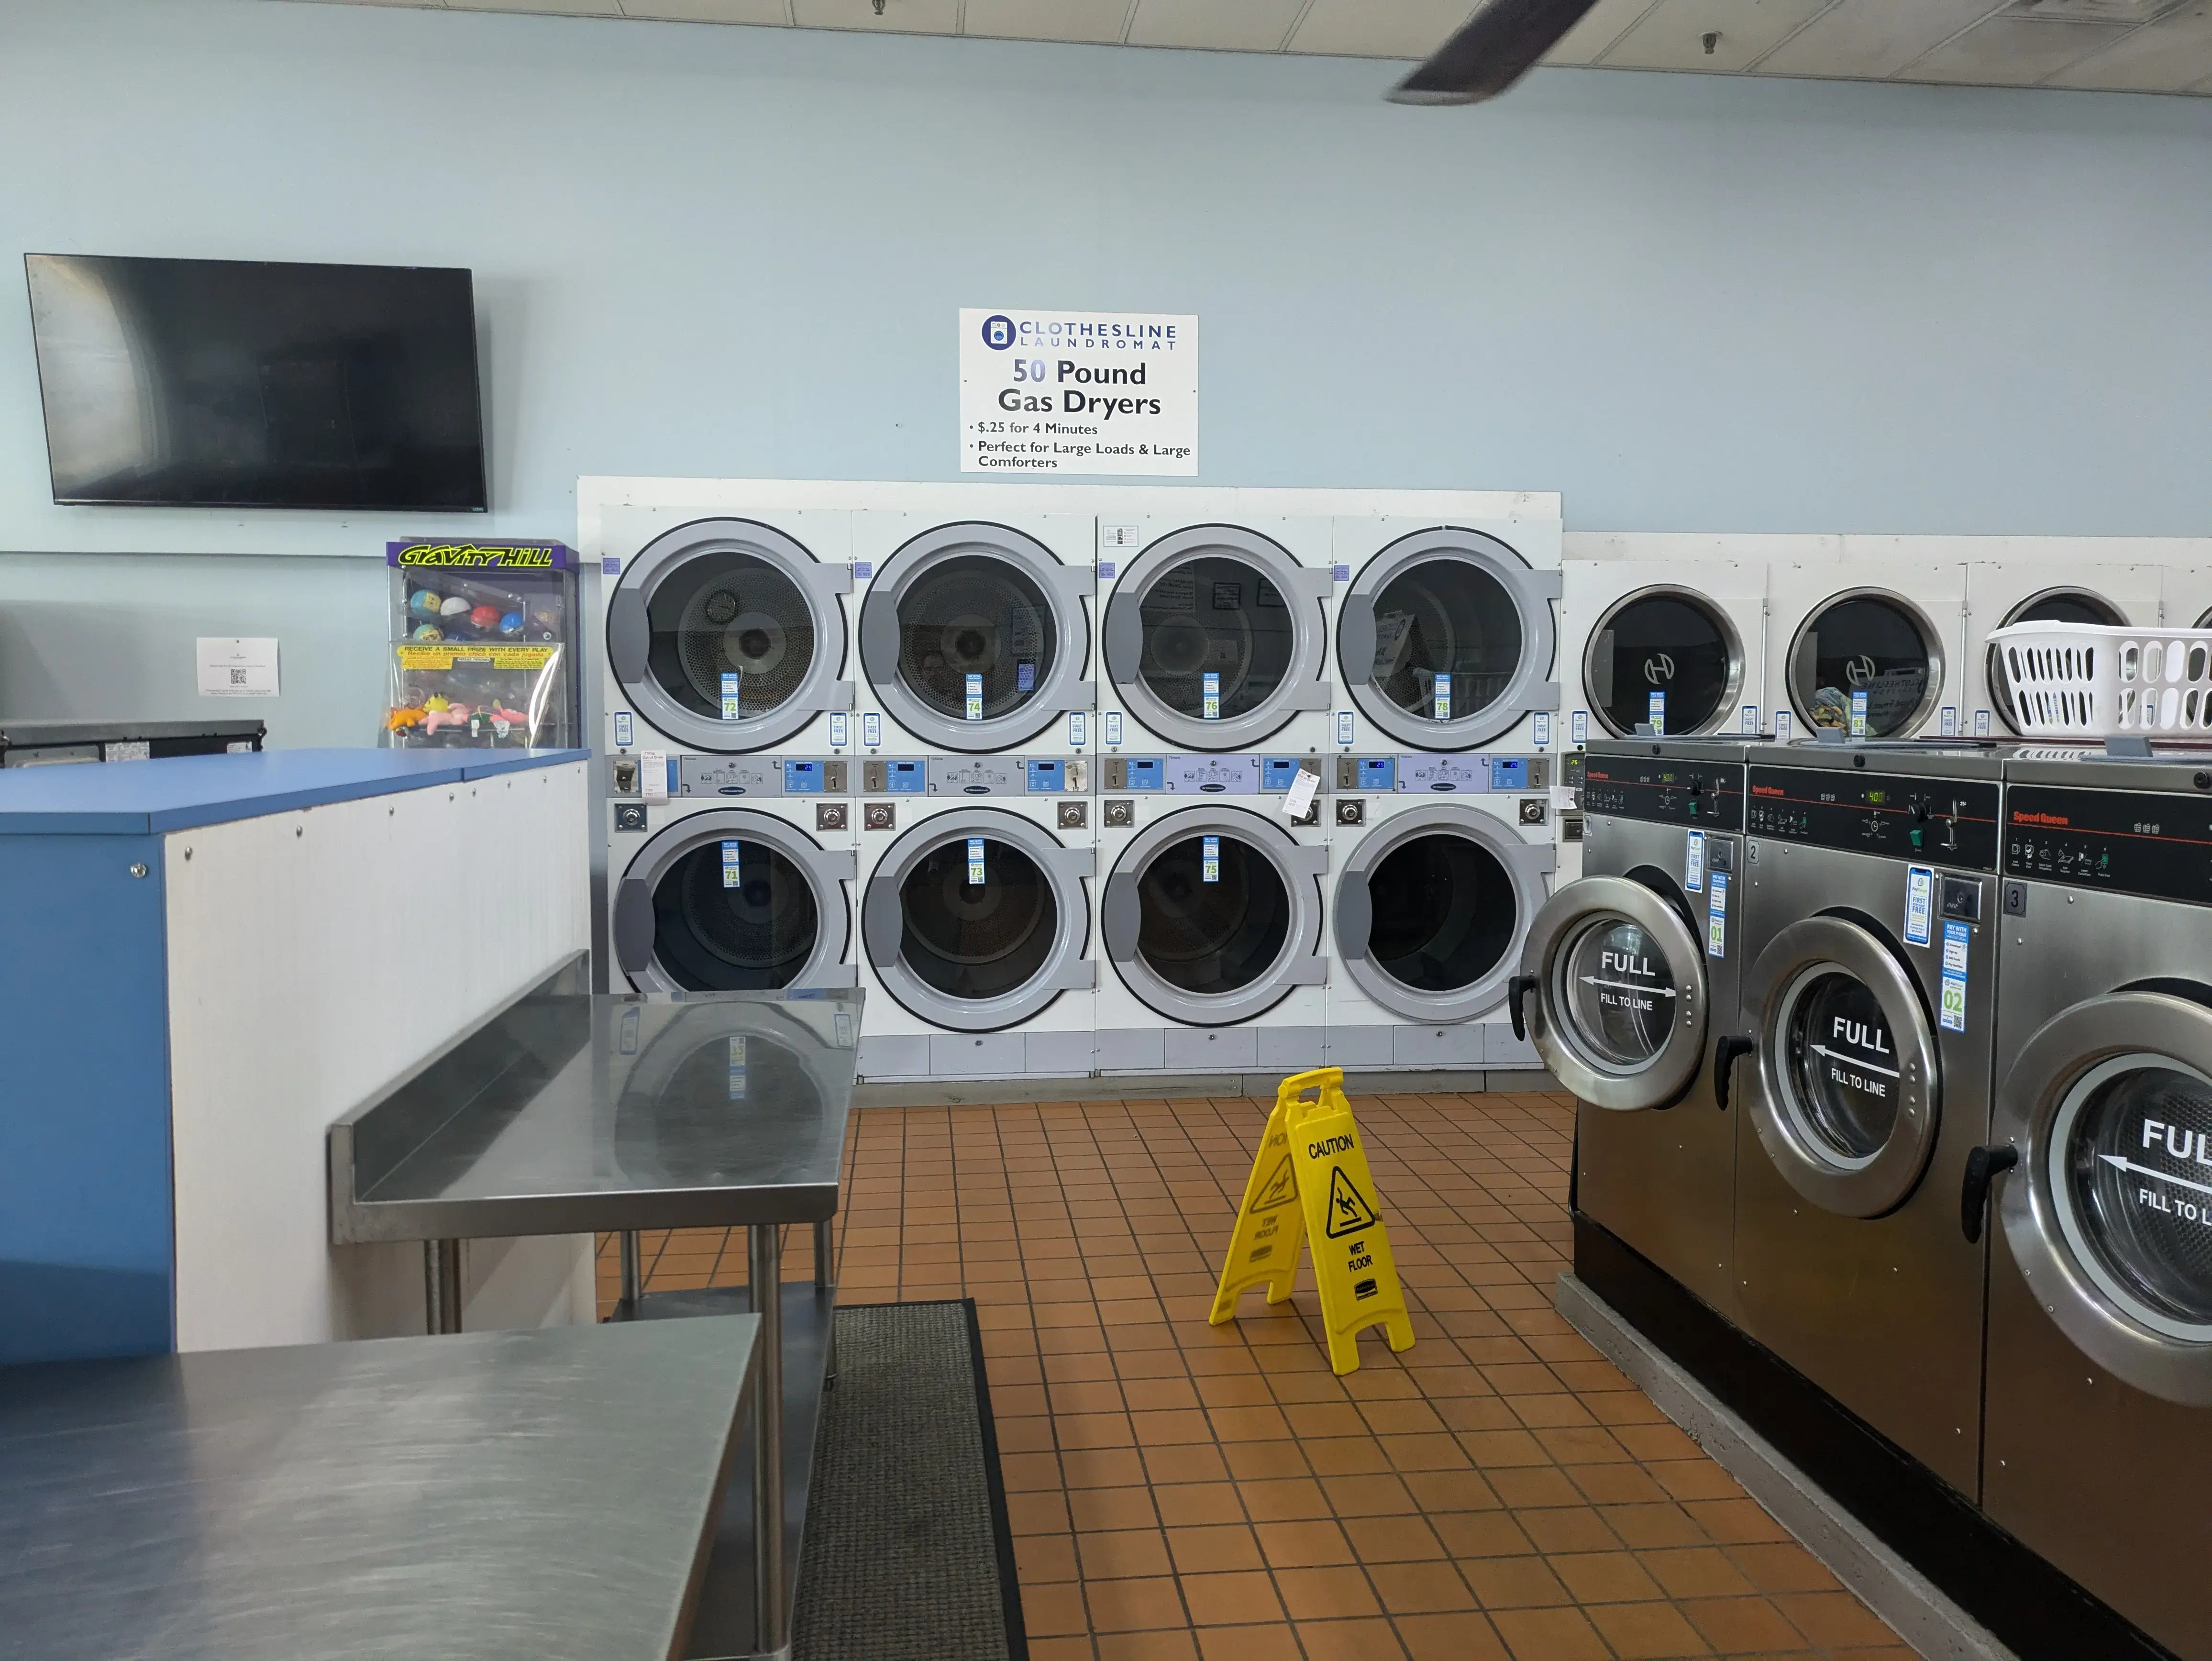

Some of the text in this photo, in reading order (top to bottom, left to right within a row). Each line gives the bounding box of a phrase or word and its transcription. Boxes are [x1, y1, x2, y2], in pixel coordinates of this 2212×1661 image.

[1019, 321, 1176, 338] CLOTHESLINE
[1020, 337, 1176, 350] LAUNDROMAT
[1013, 359, 1146, 385] 50 Pound
[998, 388, 1161, 420] Gas Dryers
[978, 421, 1098, 434] $.25 for 4 Minutes
[978, 441, 1191, 458] Perfect for Large Loads & Large
[978, 455, 1057, 468] Comforters
[724, 703, 736, 711] 72
[1206, 702, 1217, 710] 76
[1651, 720, 1662, 728] 79
[1869, 792, 1883, 802] 400
[2013, 811, 2068, 825] Speed Queen
[1750, 845, 1756, 860] 2
[971, 868, 983, 876] 73
[1206, 865, 1217, 874] 75
[2010, 890, 2019, 908] 3
[1912, 906, 1925, 914] FREE
[1711, 926, 1723, 942] 01
[1602, 951, 1655, 976] FULL
[1601, 993, 1653, 1011] FILL TO LINE
[1944, 990, 1962, 1012] 02
[1833, 1016, 1890, 1054] FULL
[1831, 1068, 1886, 1097] FILL TO LINE
[1308, 1134, 1354, 1159] CAUTION
[2139, 1188, 2171, 1213] FILL
[2174, 1200, 2197, 1220] TO
[1349, 1241, 1365, 1256] WET
[1348, 1254, 1373, 1273] FLOOR
